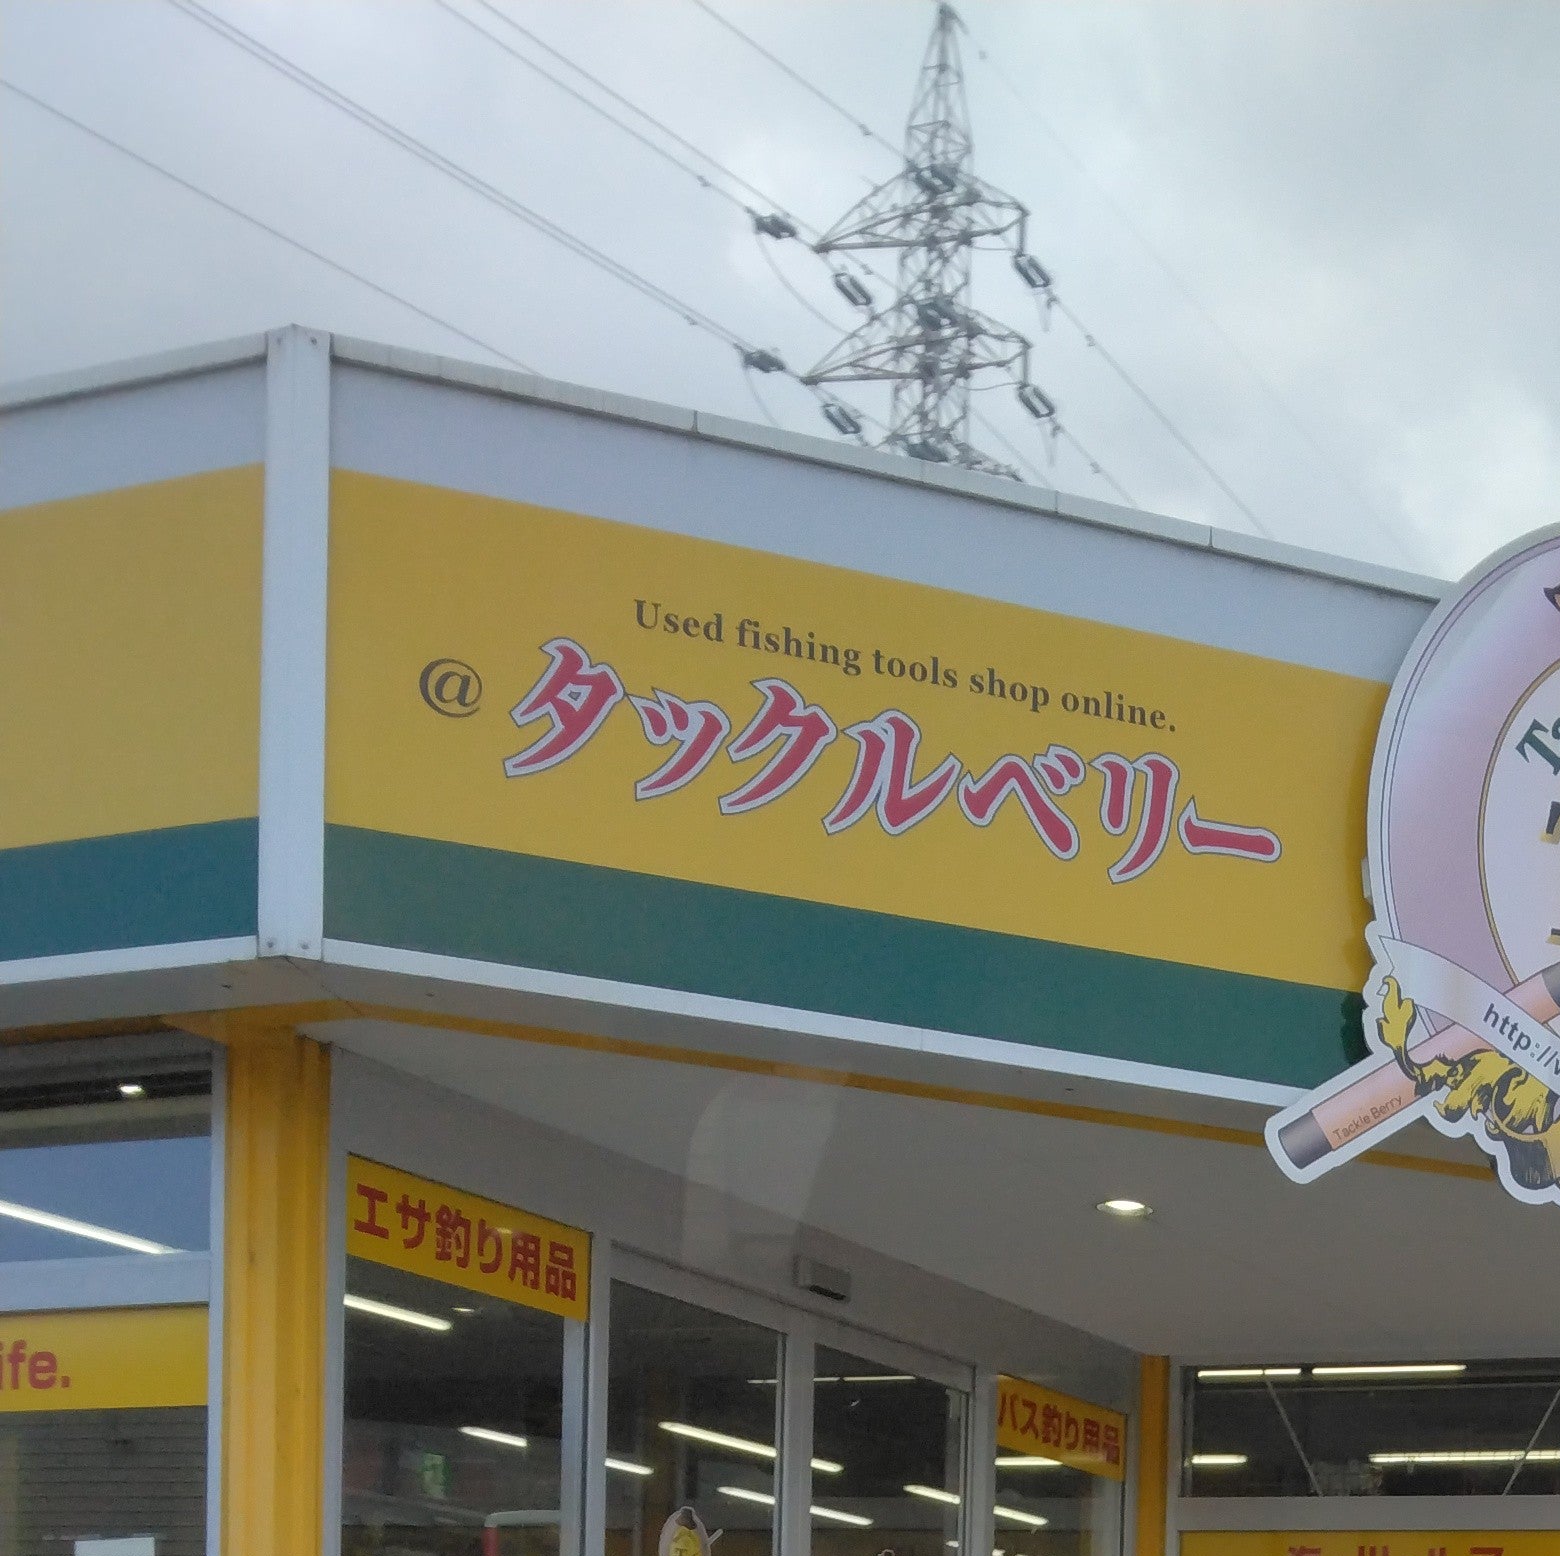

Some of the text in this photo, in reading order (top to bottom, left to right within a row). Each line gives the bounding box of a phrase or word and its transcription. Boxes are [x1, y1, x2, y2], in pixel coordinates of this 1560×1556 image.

[634, 600, 1177, 733] Used fishing tools shop online.
[418, 636, 1283, 885] @ タックルベリー
[1332, 1095, 1403, 1140] Tackle Berry
[353, 1182, 579, 1302] エサ釣り用品
